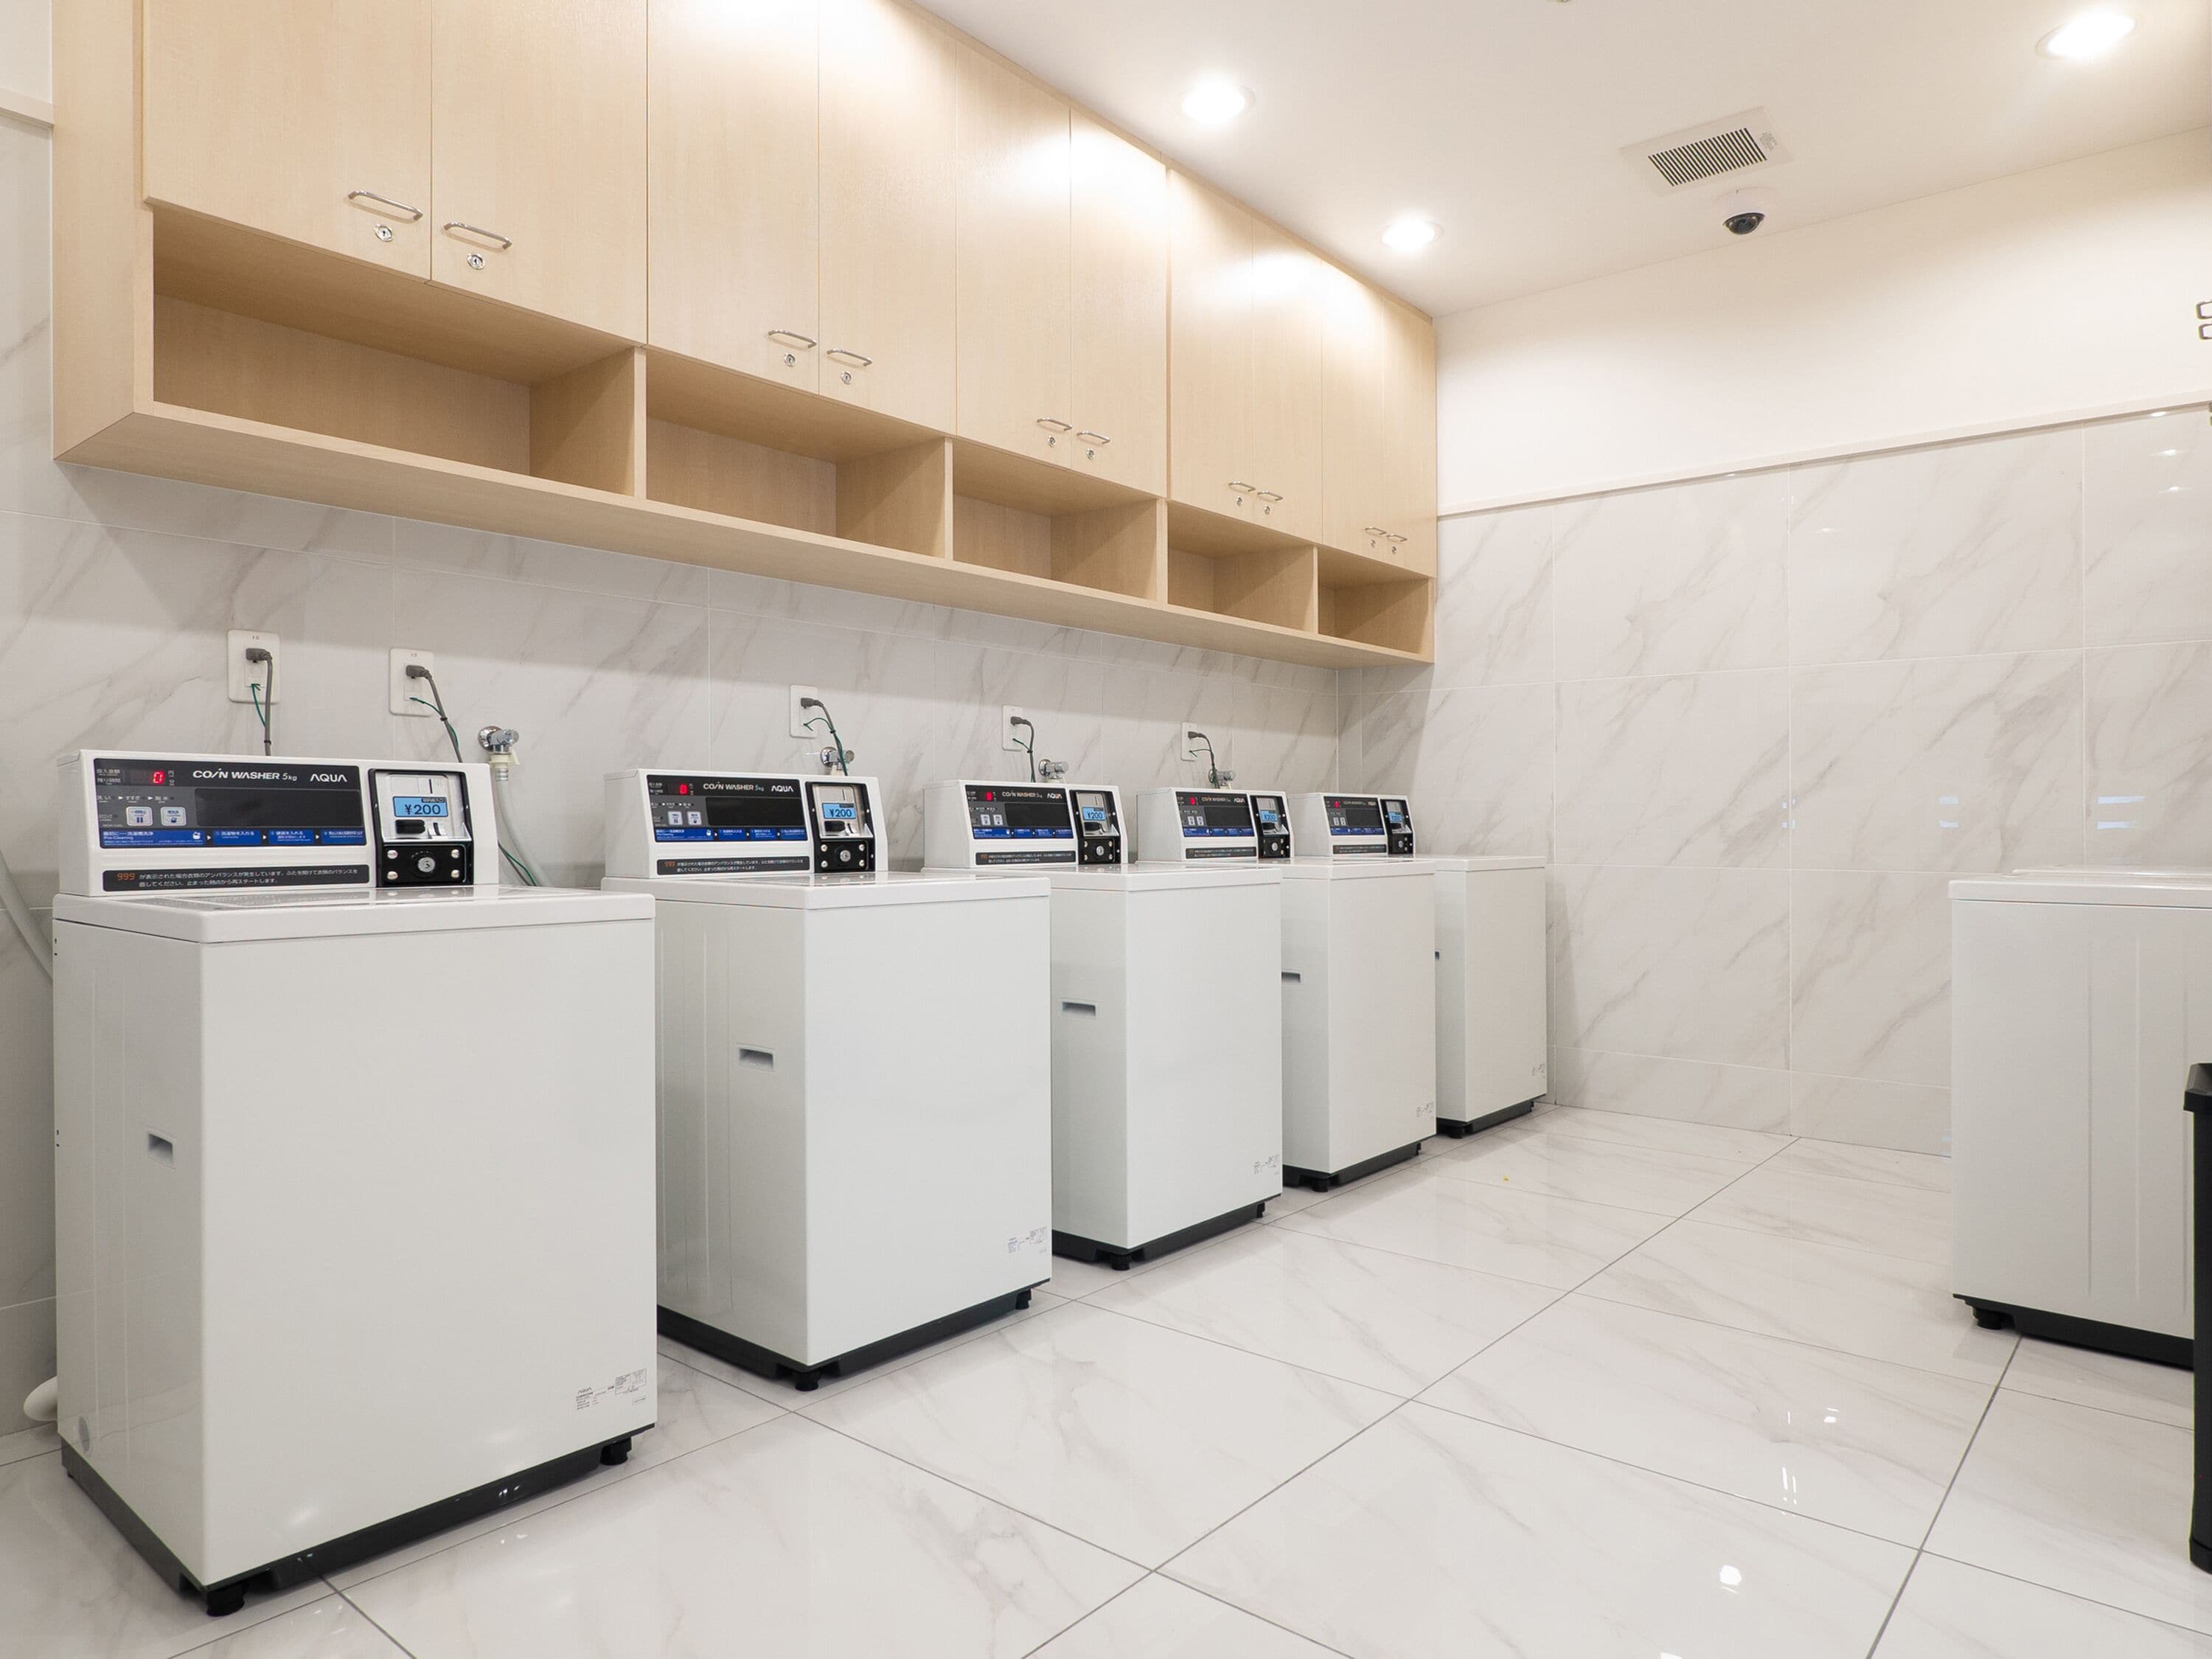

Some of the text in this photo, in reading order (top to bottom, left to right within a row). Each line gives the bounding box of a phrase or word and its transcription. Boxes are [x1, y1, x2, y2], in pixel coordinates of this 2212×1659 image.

[232, 772, 280, 780] WASHER
[282, 773, 298, 782] 5kg
[310, 773, 347, 782] AQUA
[405, 804, 441, 815] ¥200
[830, 809, 852, 818] ¥200
[1087, 811, 1103, 820] ¥200
